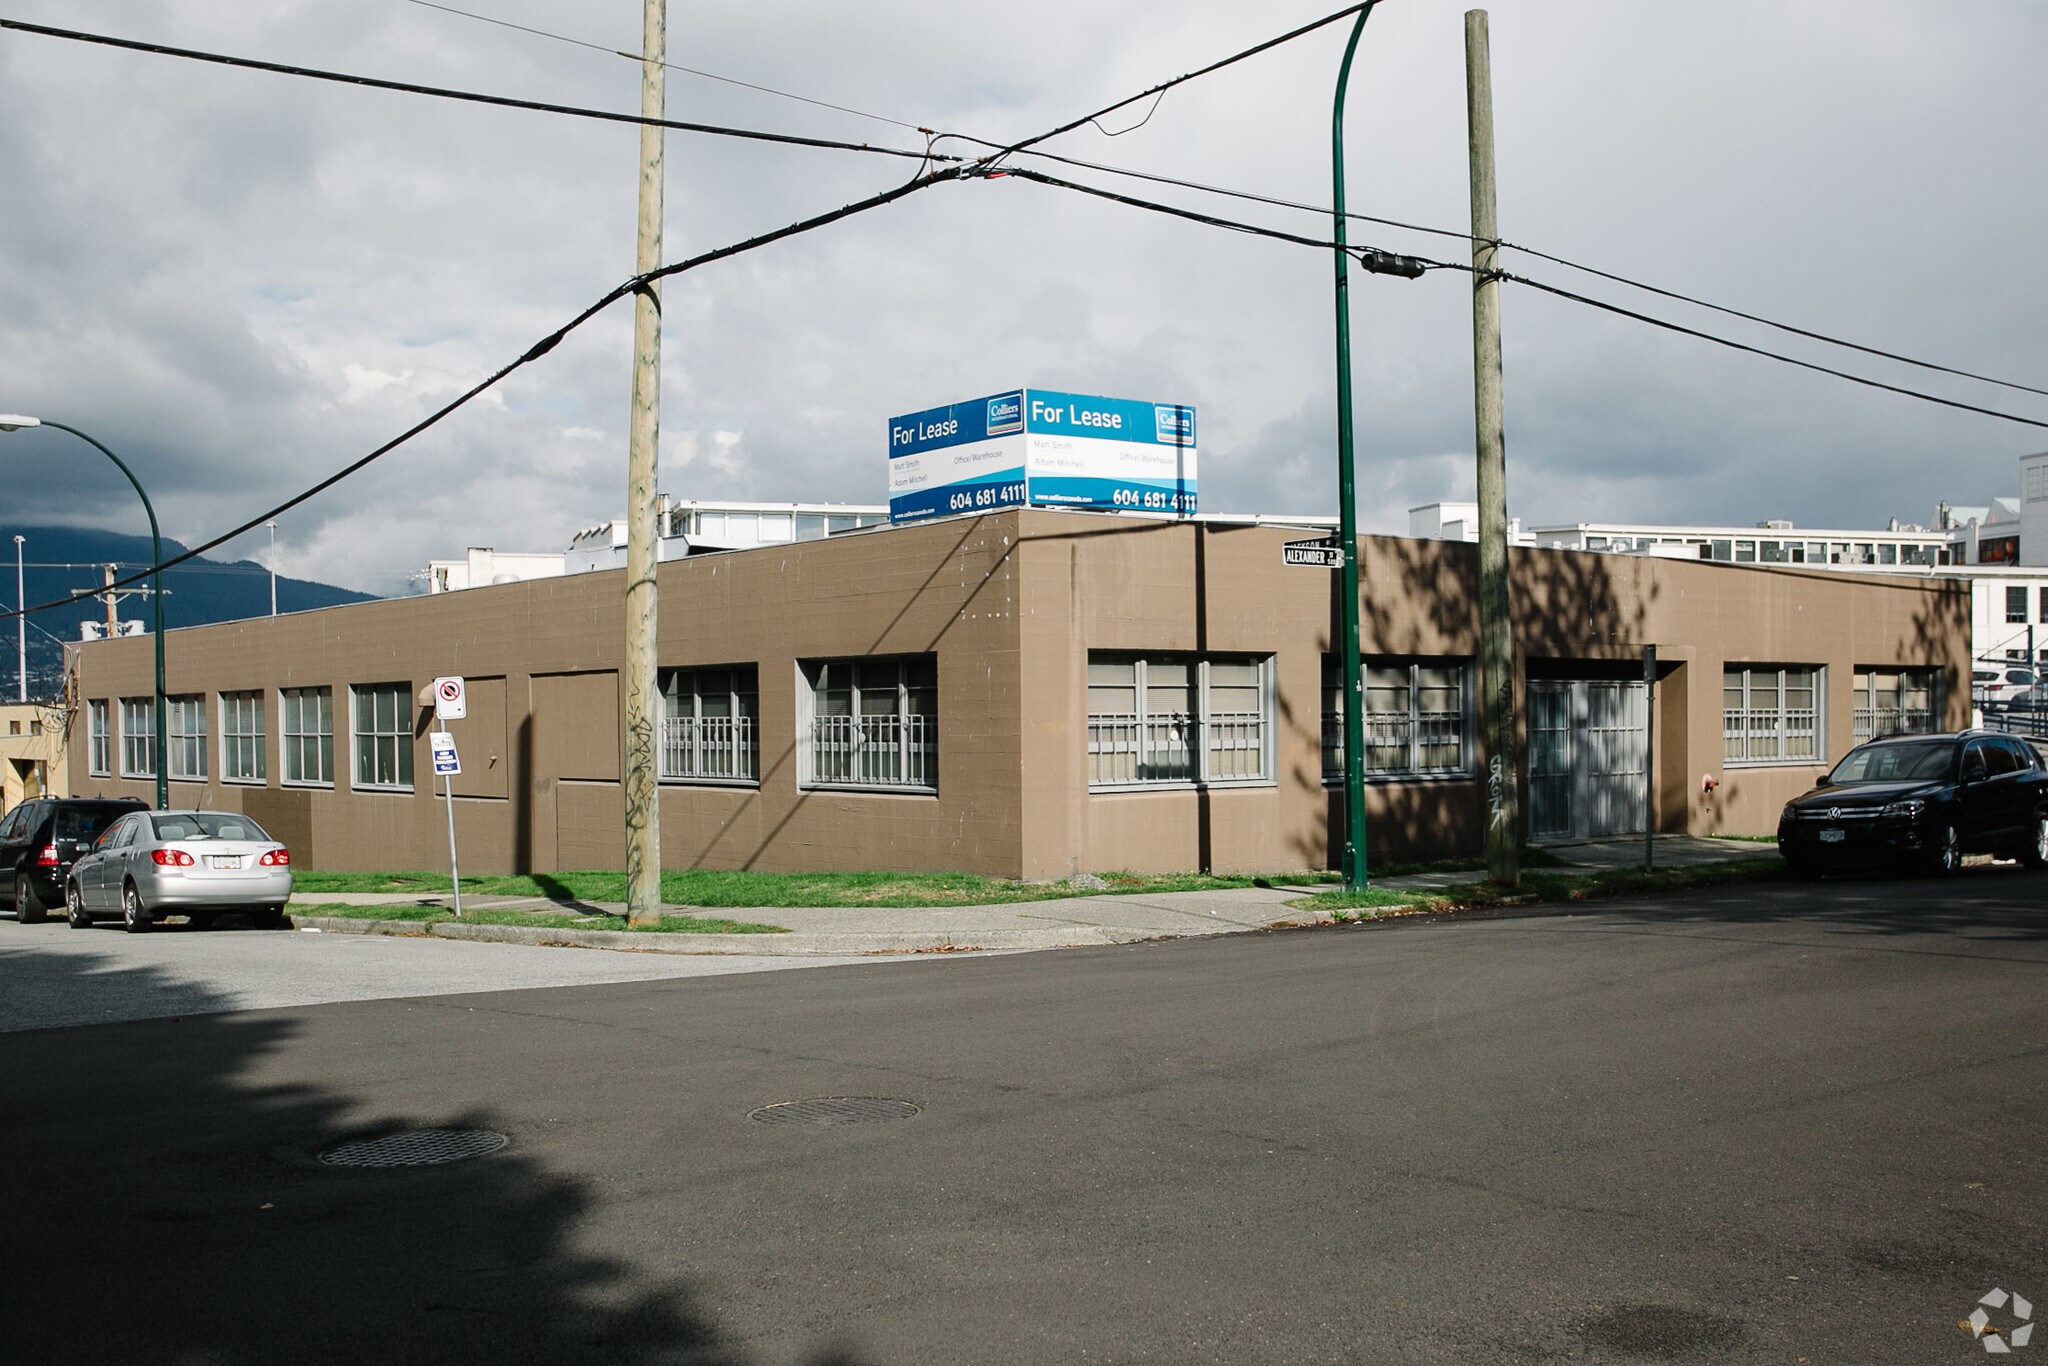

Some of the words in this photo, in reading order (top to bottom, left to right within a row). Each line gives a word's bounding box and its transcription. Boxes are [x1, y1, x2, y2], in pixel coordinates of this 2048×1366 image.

[991, 404, 1018, 416] Colliers
[1032, 400, 1064, 423] For
[1070, 404, 1122, 428] Lease
[893, 426, 914, 446] For
[919, 420, 958, 440] Lease
[1052, 441, 1072, 450] Smith
[906, 460, 920, 468] Smith
[954, 450, 1002, 465] Office/Warehouse
[1035, 458, 1056, 466] Adam
[1058, 460, 1084, 468] Mitchell
[894, 478, 908, 486] Adam
[909, 474, 928, 484] Mitchell
[950, 492, 972, 510] 604
[976, 488, 996, 506] 681
[1000, 484, 1024, 502] 4111
[1112, 489, 1140, 506] 604
[1144, 492, 1166, 508] 681
[1170, 494, 1196, 510] 4111
[1286, 550, 1325, 564] ALEXANDER
